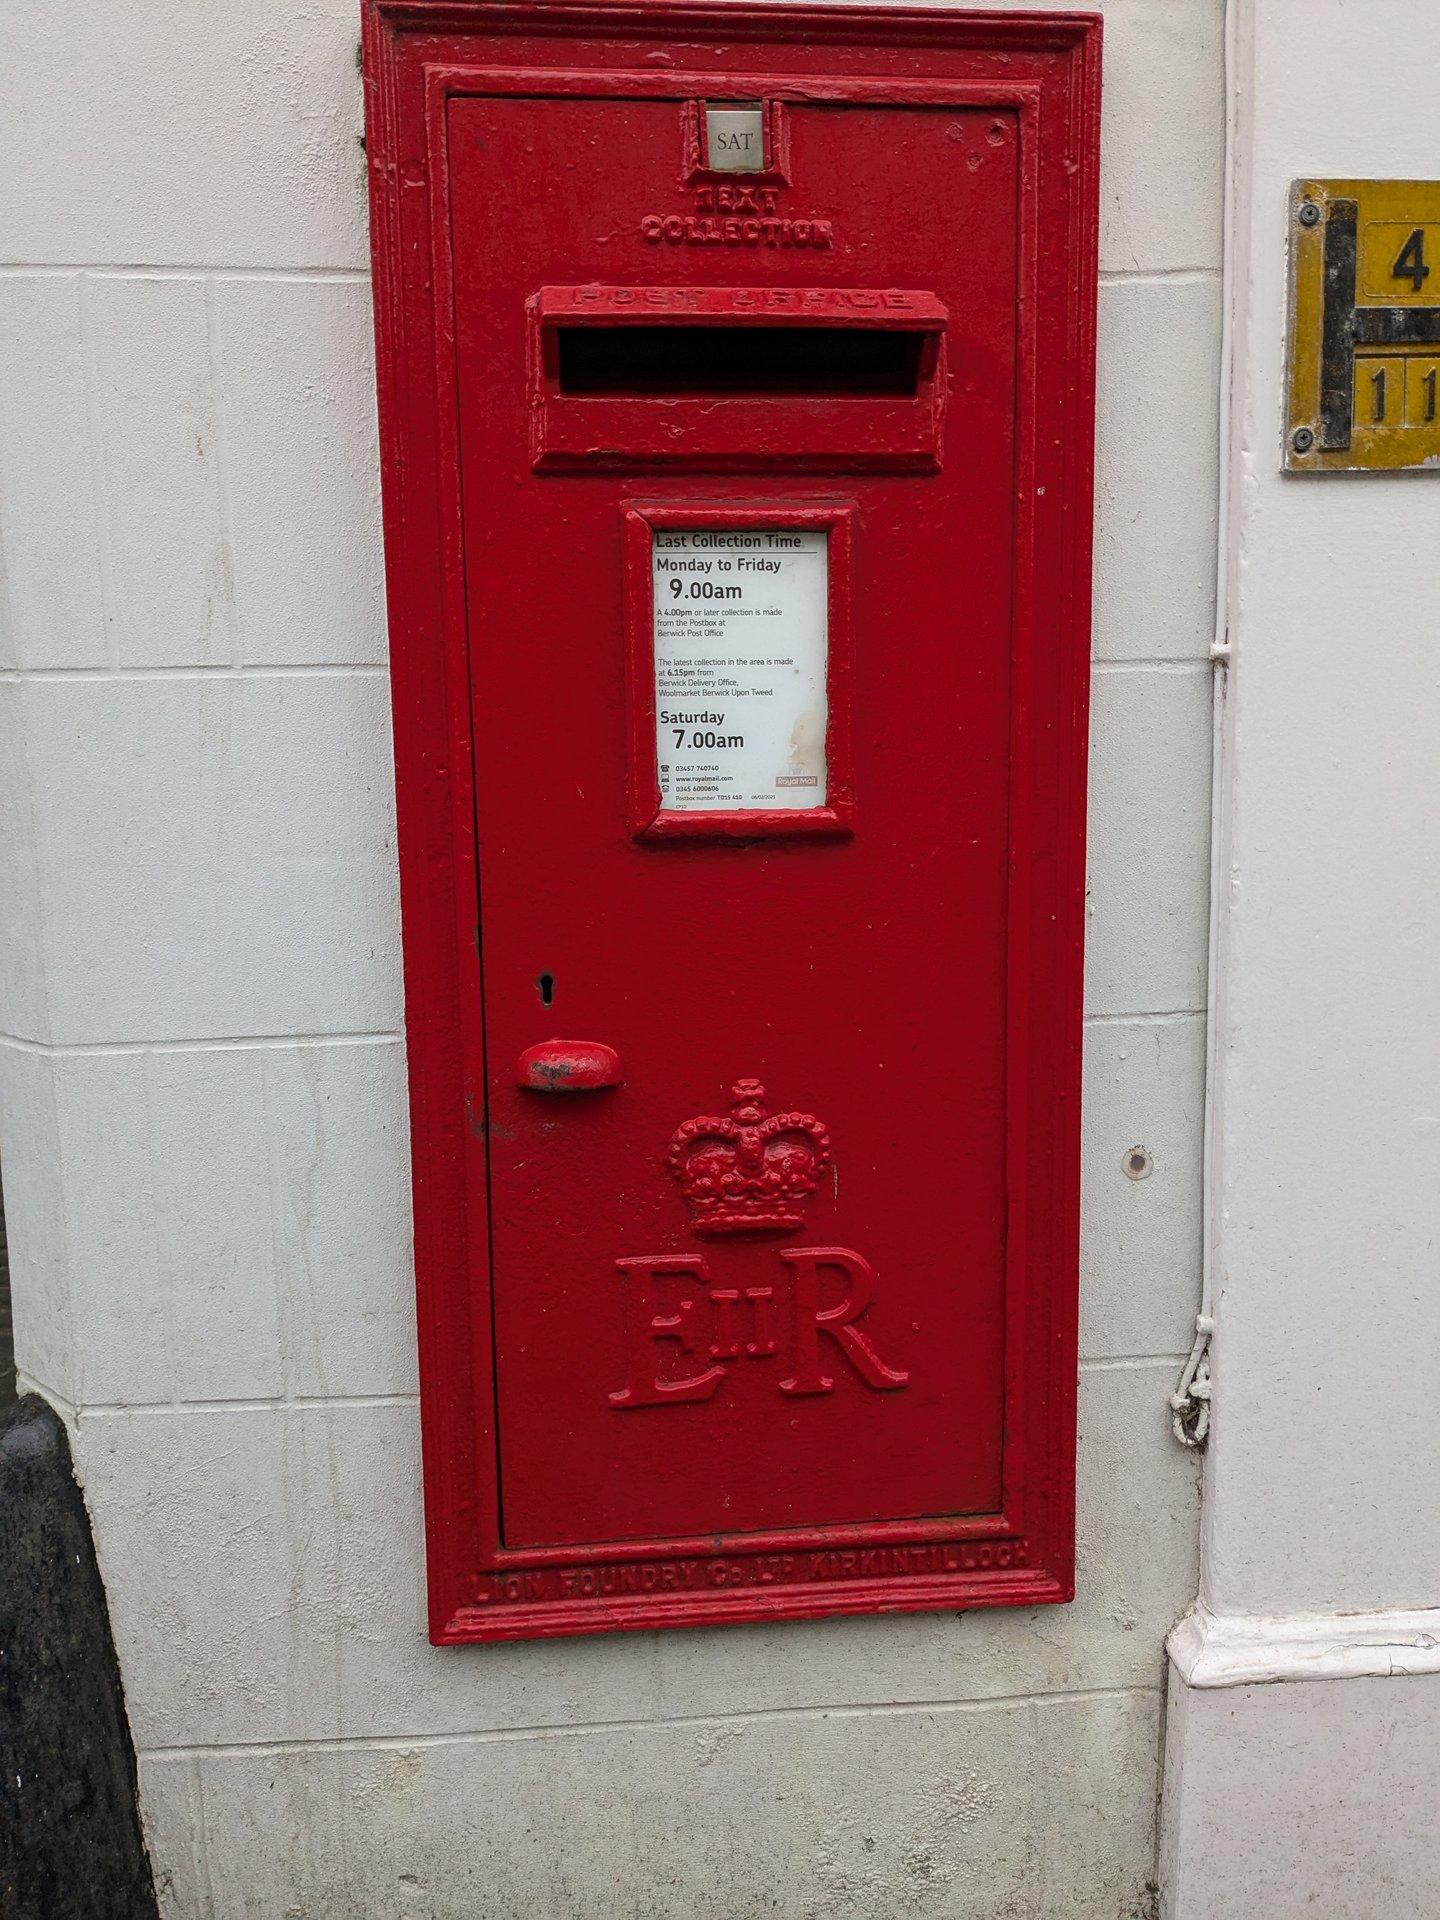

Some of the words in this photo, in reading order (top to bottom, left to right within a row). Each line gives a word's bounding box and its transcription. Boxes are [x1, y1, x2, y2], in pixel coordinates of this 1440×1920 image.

[717, 132, 754, 150] SAT
[641, 214, 833, 245] COLLECTION
[1393, 228, 1430, 291] 4
[572, 286, 705, 306] POST
[730, 288, 913, 310] OFFICE
[656, 534, 687, 548] Last
[692, 534, 762, 548] Collection
[766, 534, 802, 548] Time
[657, 558, 713, 574] Monday
[718, 559, 732, 571] to
[737, 558, 782, 573] Friday
[669, 578, 743, 599] 9.00am
[664, 609, 693, 617] 4.00pm
[722, 608, 754, 616] collection
[763, 608, 782, 616] made
[657, 619, 674, 627] from
[676, 619, 688, 627] the
[689, 619, 717, 627] Postbox
[657, 629, 686, 637] Berwick
[687, 629, 703, 637] Post
[704, 629, 724, 637] Office
[658, 669, 666, 677] at
[667, 669, 695, 678] 6.15pm
[658, 679, 687, 687] Berwick
[688, 679, 716, 688] Delivery
[658, 689, 701, 697] Woolmarket
[702, 689, 730, 697] Berwick
[731, 689, 750, 697] Upon
[751, 689, 773, 697] Tweed
[660, 711, 725, 726] Saturday
[672, 729, 744, 749] 7.00am
[675, 775, 734, 783] www.royalmail.com
[778, 778, 799, 786] Royal
[799, 777, 816, 785] Mail
[560, 1560, 698, 1598] FOUNDRY
[809, 1539, 1030, 1580] KIRKINTILLOCH
